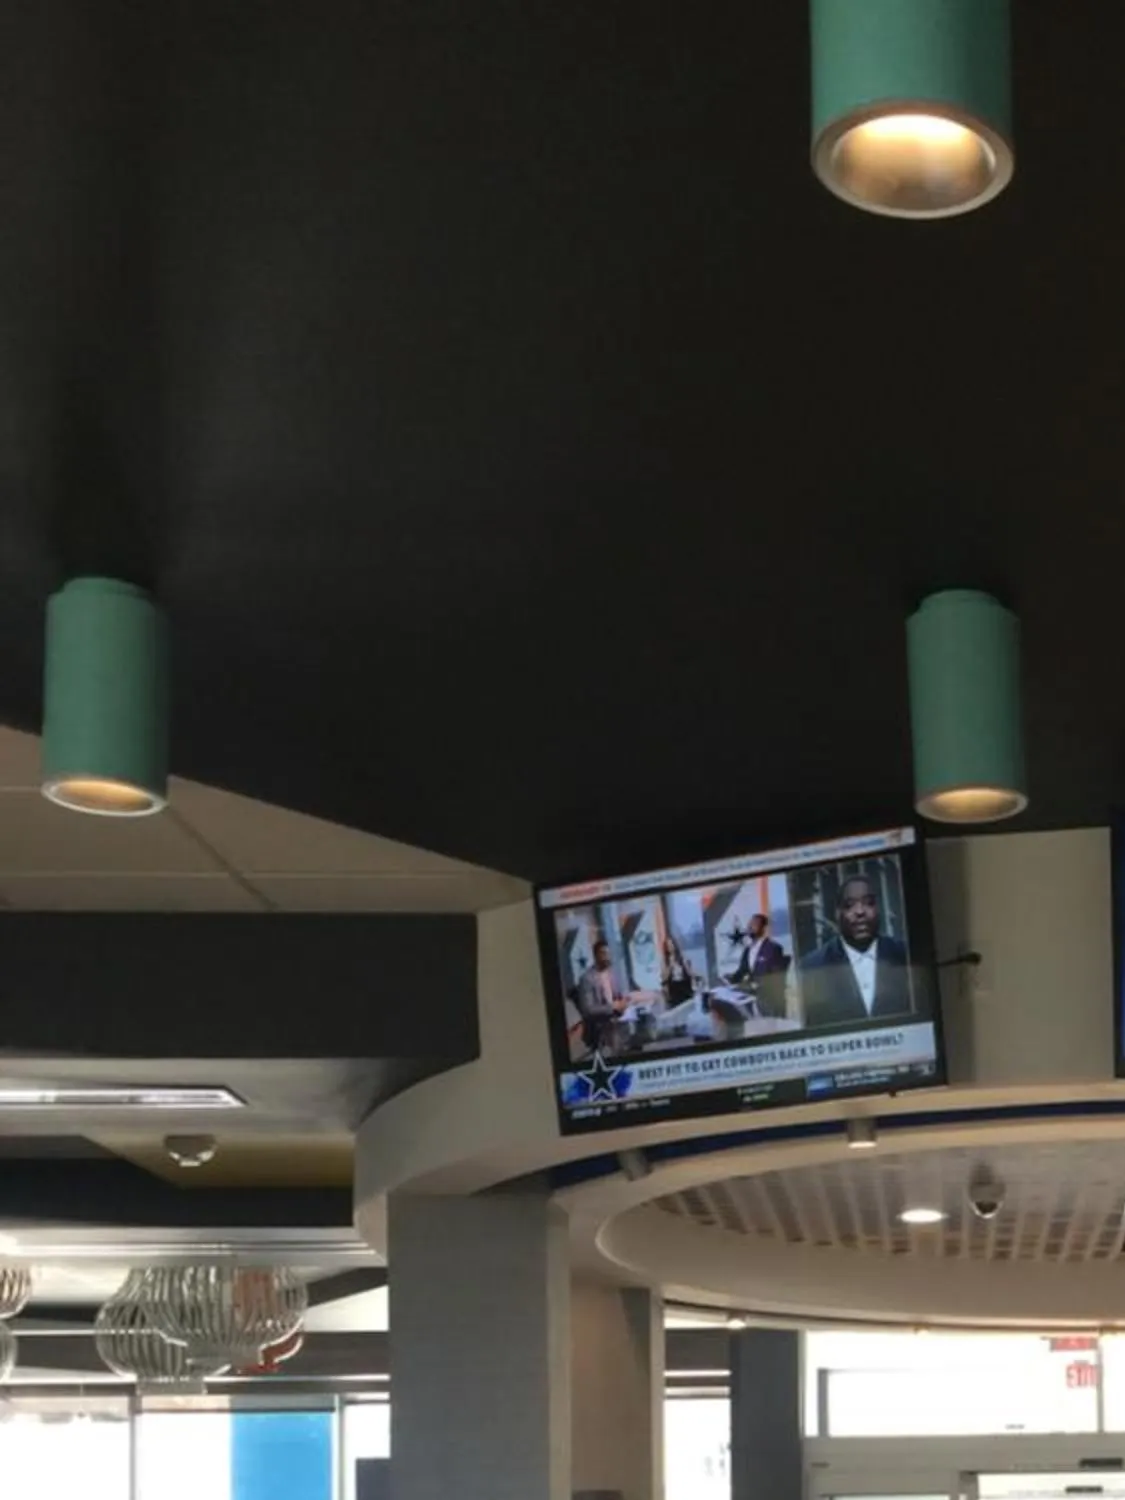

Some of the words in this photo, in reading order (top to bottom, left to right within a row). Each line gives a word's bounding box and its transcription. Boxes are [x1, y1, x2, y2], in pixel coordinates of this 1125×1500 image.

[723, 1050, 777, 1071] COWBOYS
[779, 1046, 807, 1061] BACK
[828, 1038, 862, 1055] SUPER
